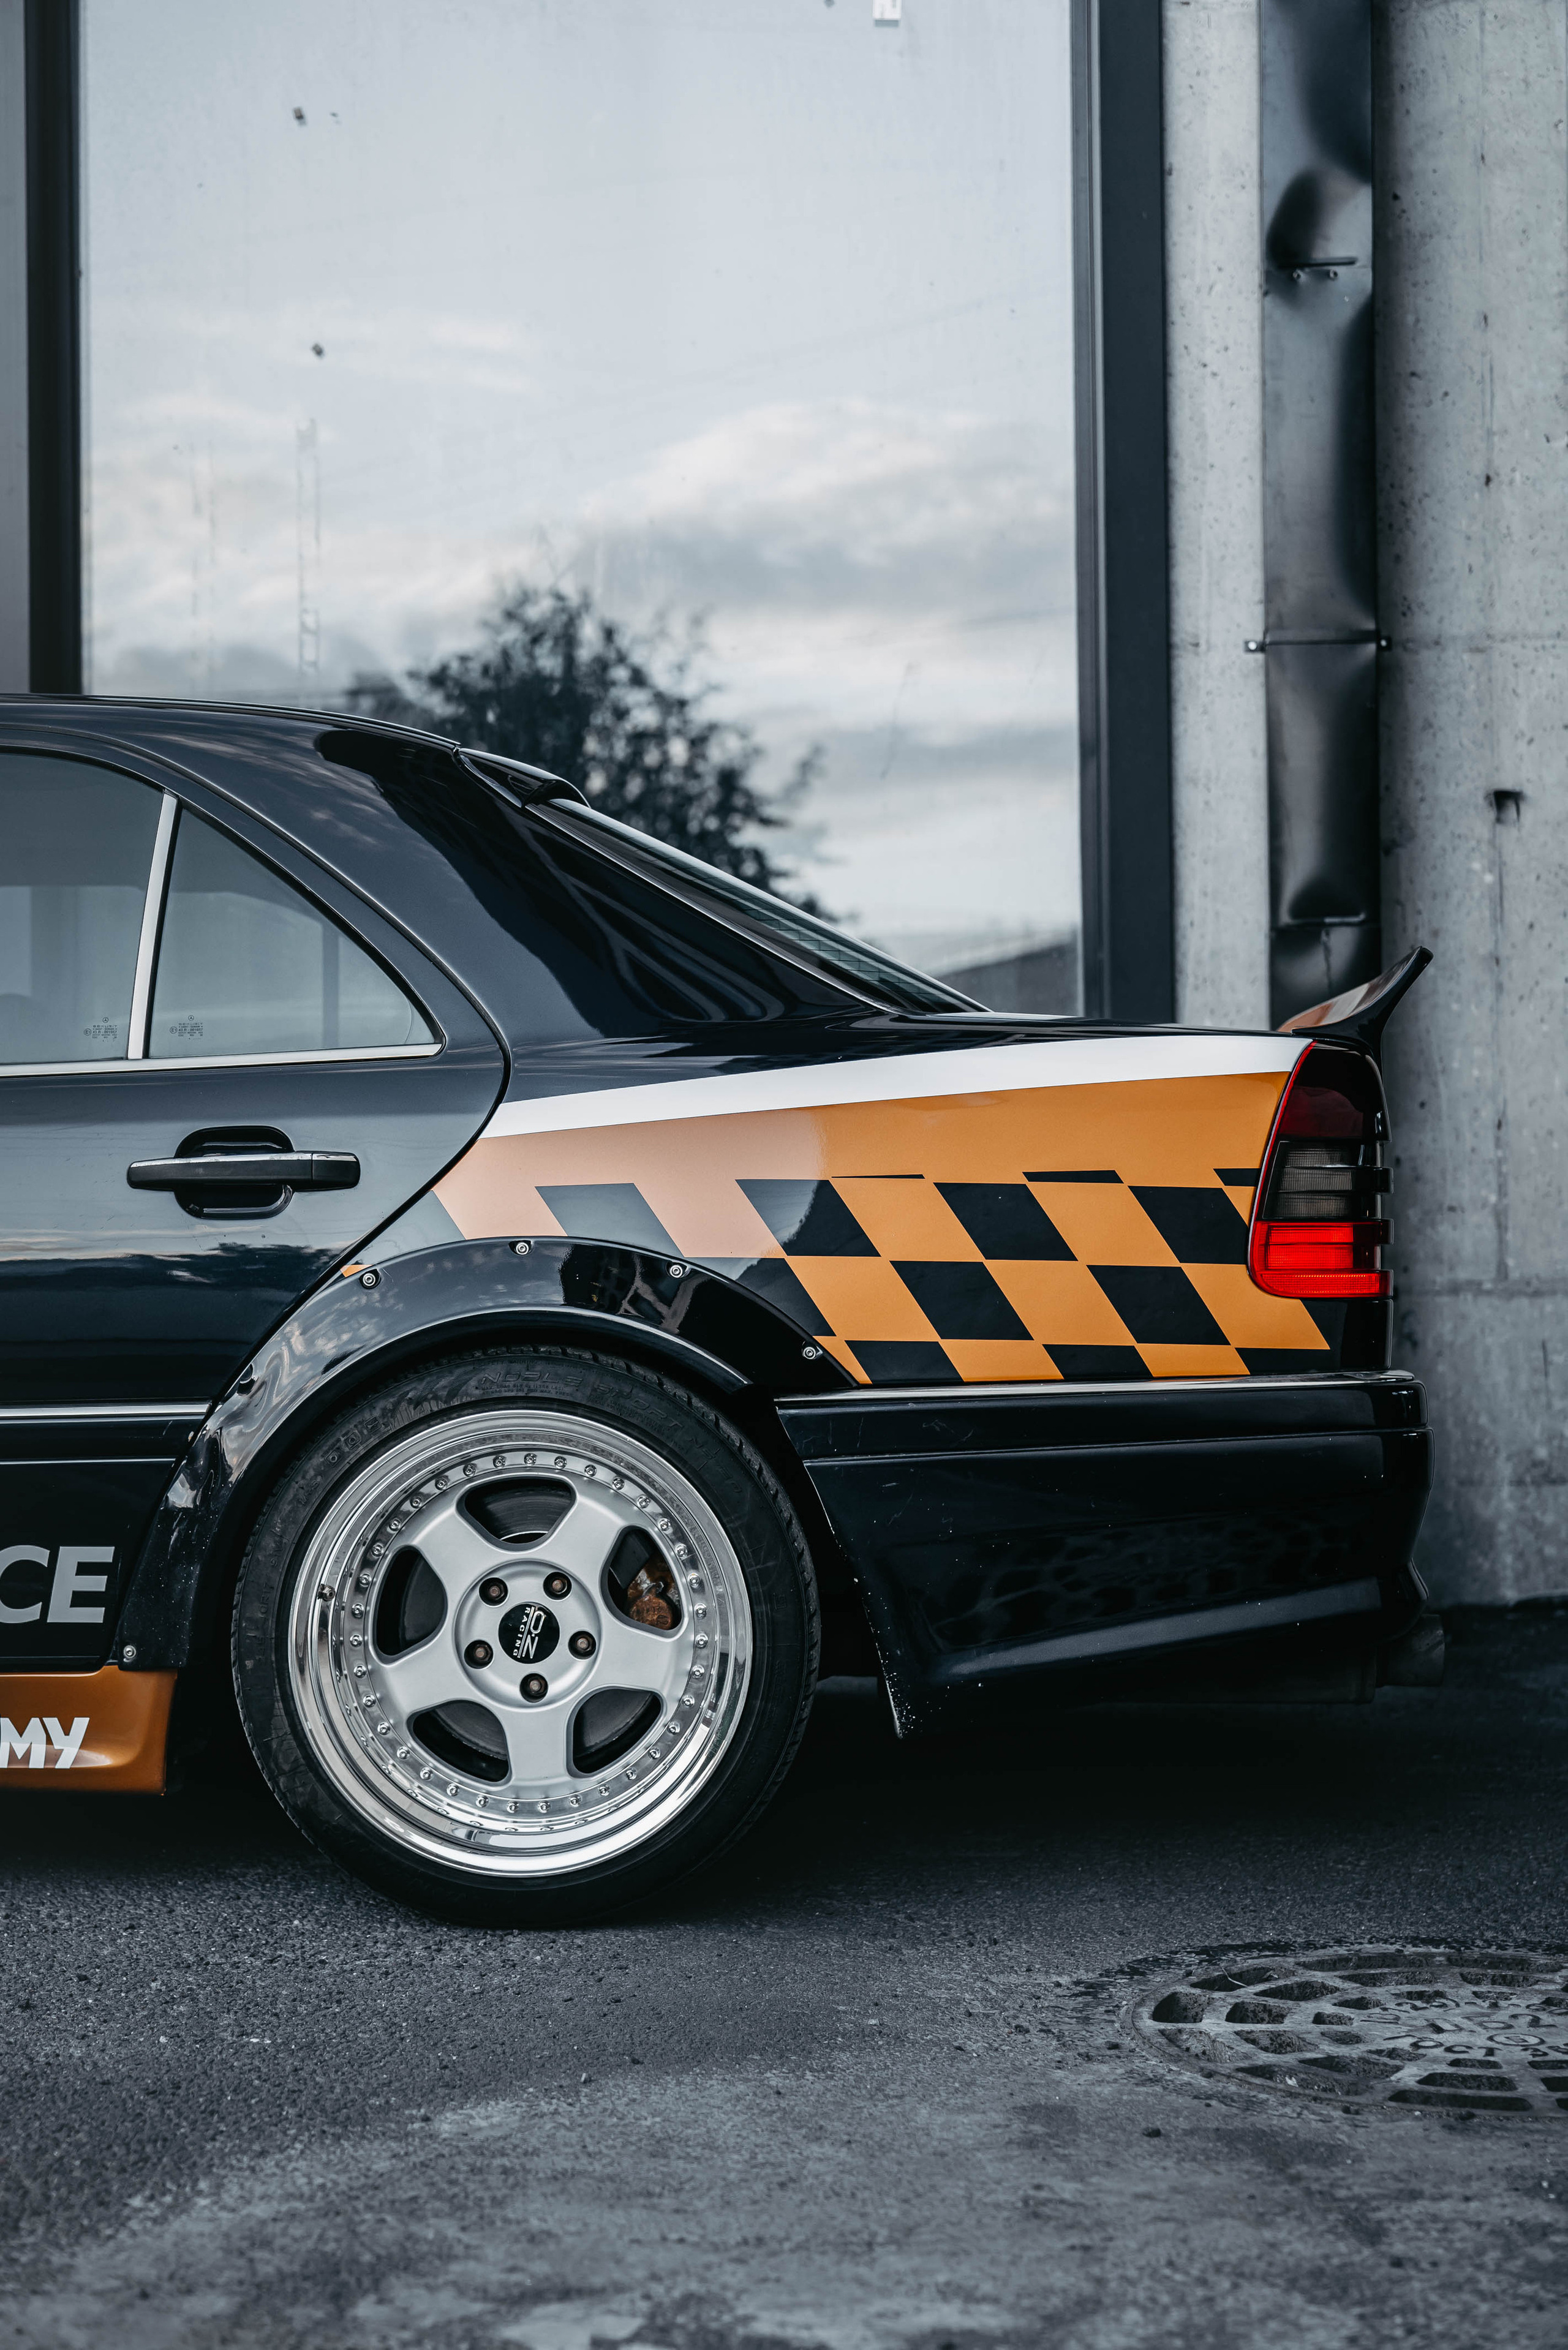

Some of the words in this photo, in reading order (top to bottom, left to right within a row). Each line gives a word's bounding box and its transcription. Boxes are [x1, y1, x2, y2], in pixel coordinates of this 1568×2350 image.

[480, 1371, 583, 1387] NOBLE
[594, 1383, 685, 1429] SPORT
[0, 1545, 115, 1624] CE
[513, 1607, 530, 1656] RACING
